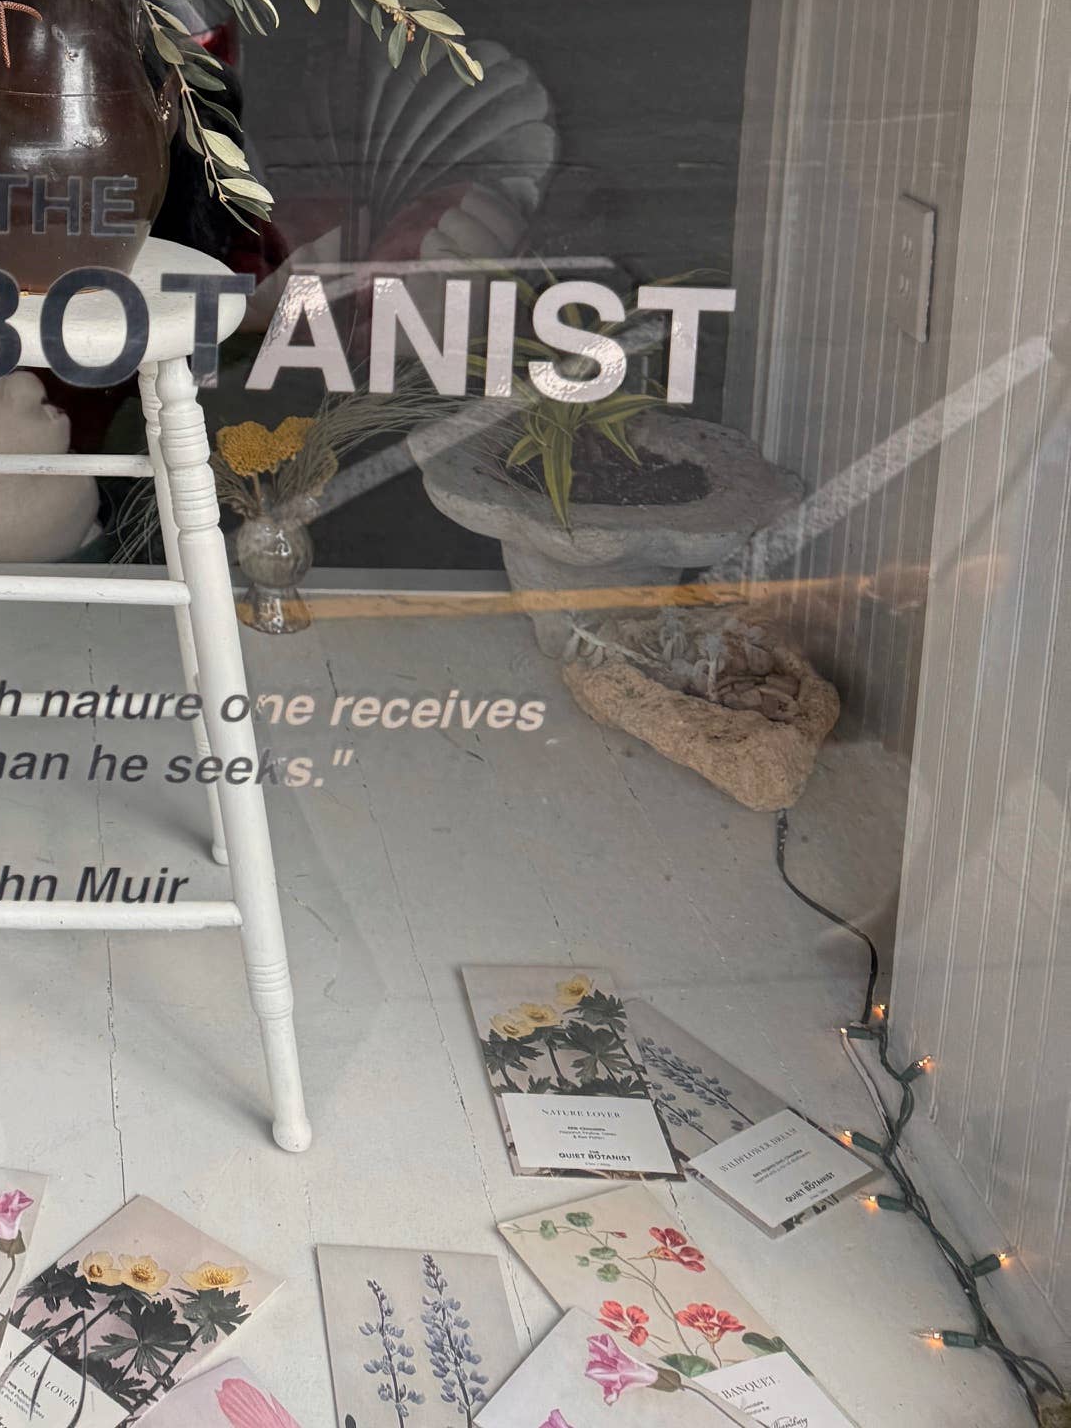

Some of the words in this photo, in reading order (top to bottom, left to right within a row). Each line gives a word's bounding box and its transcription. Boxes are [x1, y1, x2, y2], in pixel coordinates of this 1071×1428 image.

[39, 684, 204, 722] nature
[220, 693, 316, 726] one
[330, 689, 547, 732] receives
[87, 744, 149, 784] he
[164, 748, 355, 788] seeks."
[75, 866, 190, 905] Muir
[558, 1152, 586, 1161] QUIET
[587, 1153, 632, 1163] BOTANIST
[43, 1380, 79, 1409] LOVER
